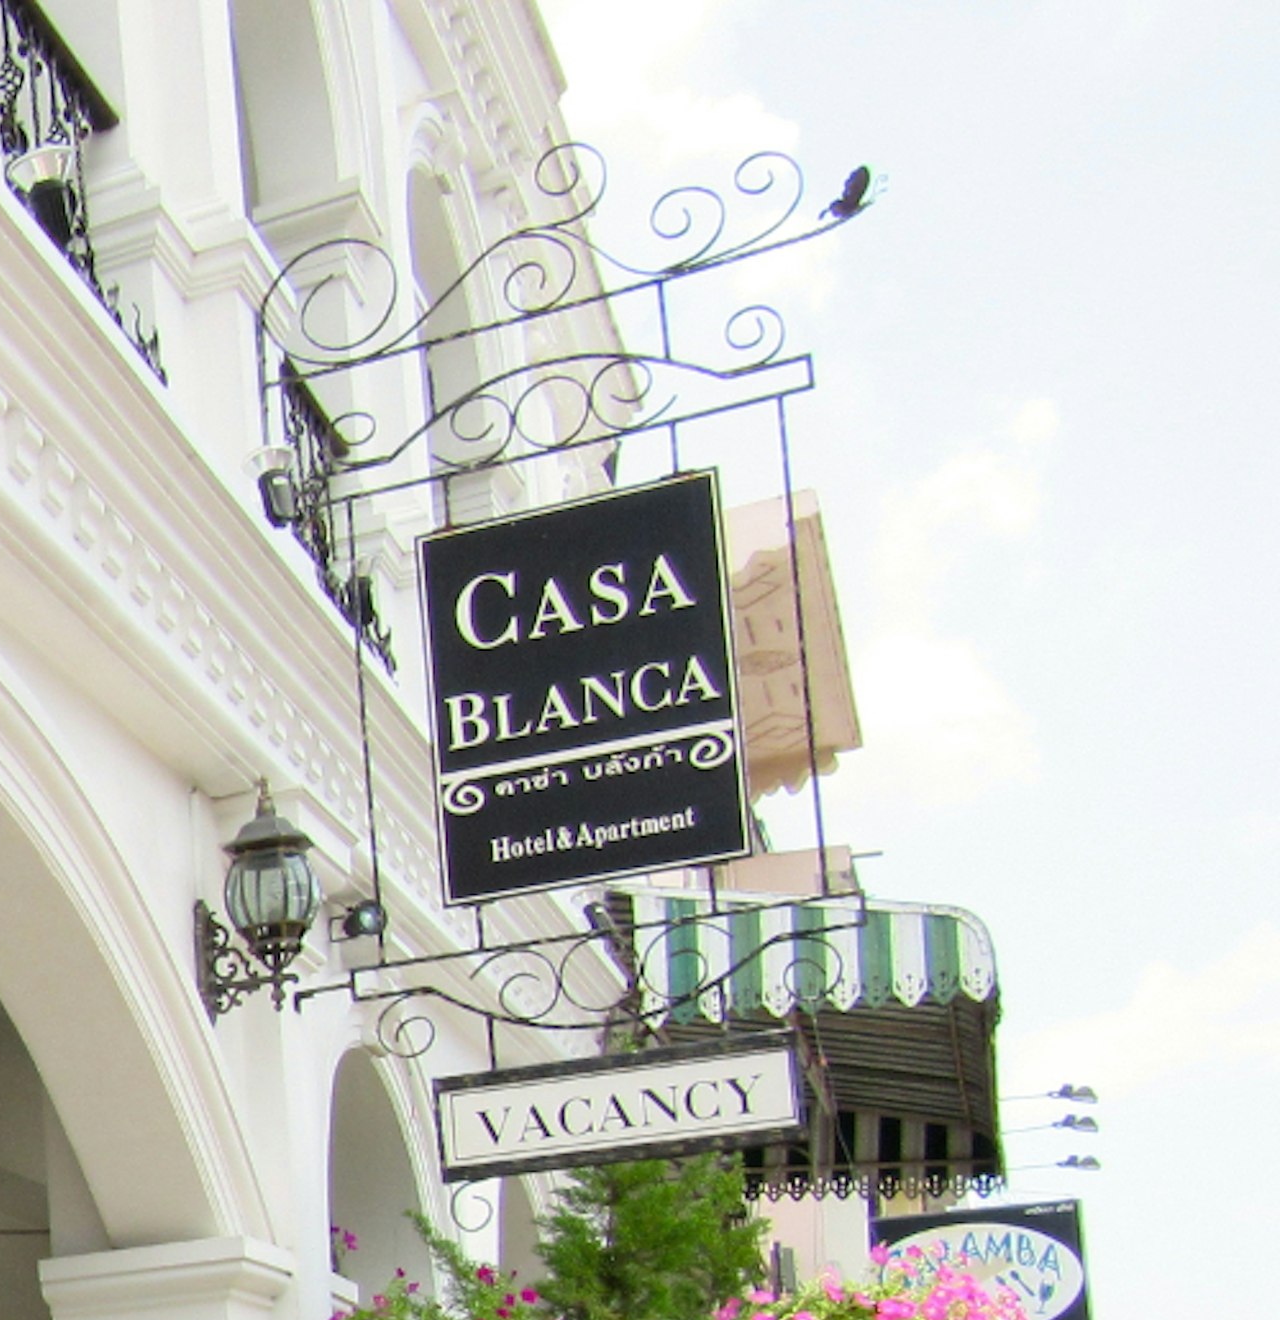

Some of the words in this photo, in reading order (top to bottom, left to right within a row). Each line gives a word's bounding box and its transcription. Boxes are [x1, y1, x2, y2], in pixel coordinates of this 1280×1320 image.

[455, 554, 697, 650] CASA
[444, 655, 723, 752] BLANCA
[476, 1074, 762, 1145] VACANCY
[886, 1231, 1061, 1288] AMBA
